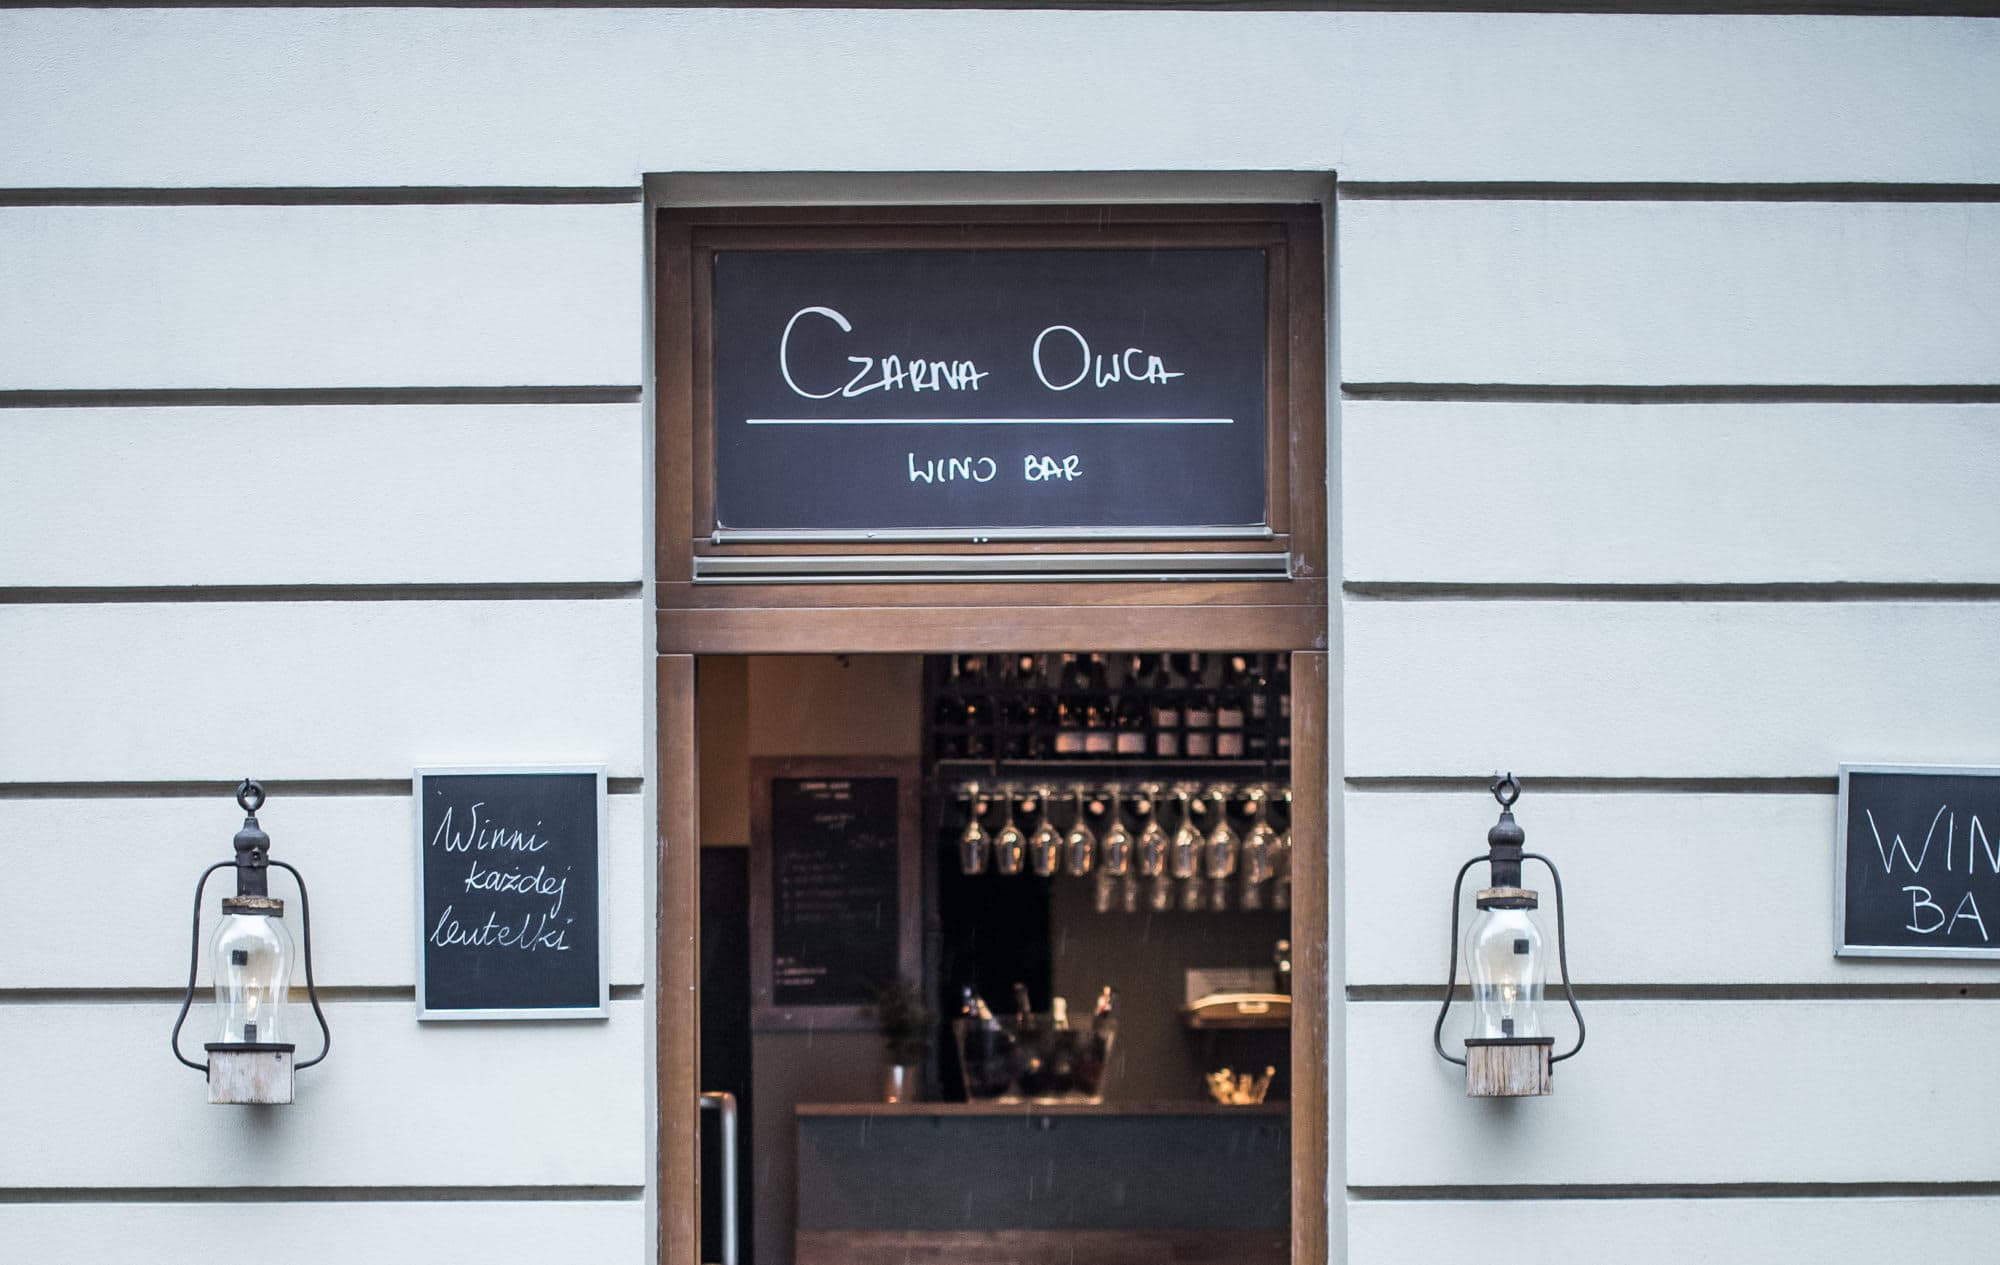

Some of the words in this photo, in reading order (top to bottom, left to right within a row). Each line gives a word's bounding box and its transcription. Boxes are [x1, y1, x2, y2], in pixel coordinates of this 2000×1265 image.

[908, 452, 997, 483] WINO
[1024, 454, 1083, 481] BAR
[432, 802, 548, 852] Winni
[1866, 804, 2000, 875] WIN
[464, 860, 572, 919] każdej
[1902, 885, 1989, 941] BA
